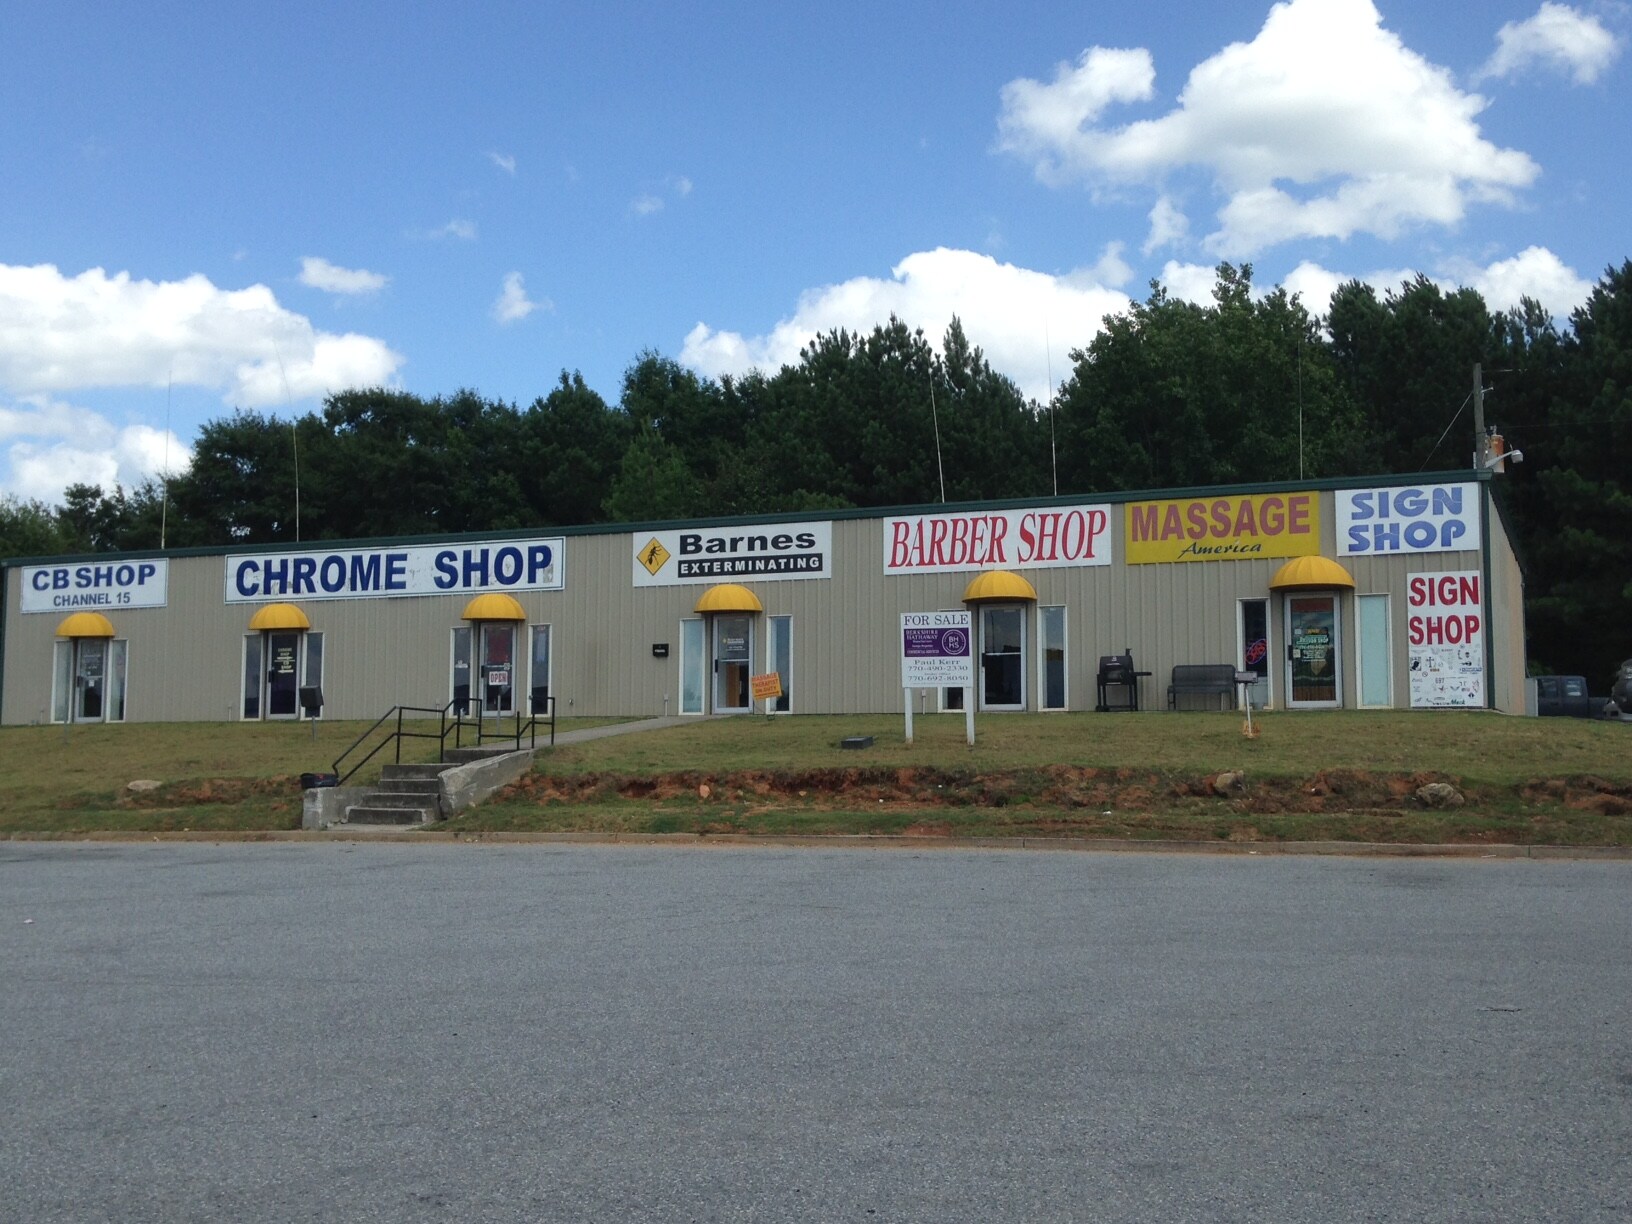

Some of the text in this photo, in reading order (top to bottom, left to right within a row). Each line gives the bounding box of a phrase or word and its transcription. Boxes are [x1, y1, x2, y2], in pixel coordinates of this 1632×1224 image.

[1351, 487, 1462, 520] SIGN
[1131, 496, 1311, 542] MASSAGE
[679, 532, 816, 555] Barnes
[888, 509, 1107, 568] BARBER SHOP
[1177, 539, 1262, 559] America
[1348, 519, 1466, 552] SHOP
[32, 563, 156, 591] CB SHOP
[236, 544, 552, 597] CHROME SHOP
[680, 556, 820, 574] EXTERMINATING
[53, 591, 131, 607] CHANNEL 15
[1409, 576, 1480, 607] SIGN
[904, 614, 969, 626] FOR SALE
[1409, 614, 1480, 645] SHOP
[490, 672, 507, 683] OPEN
